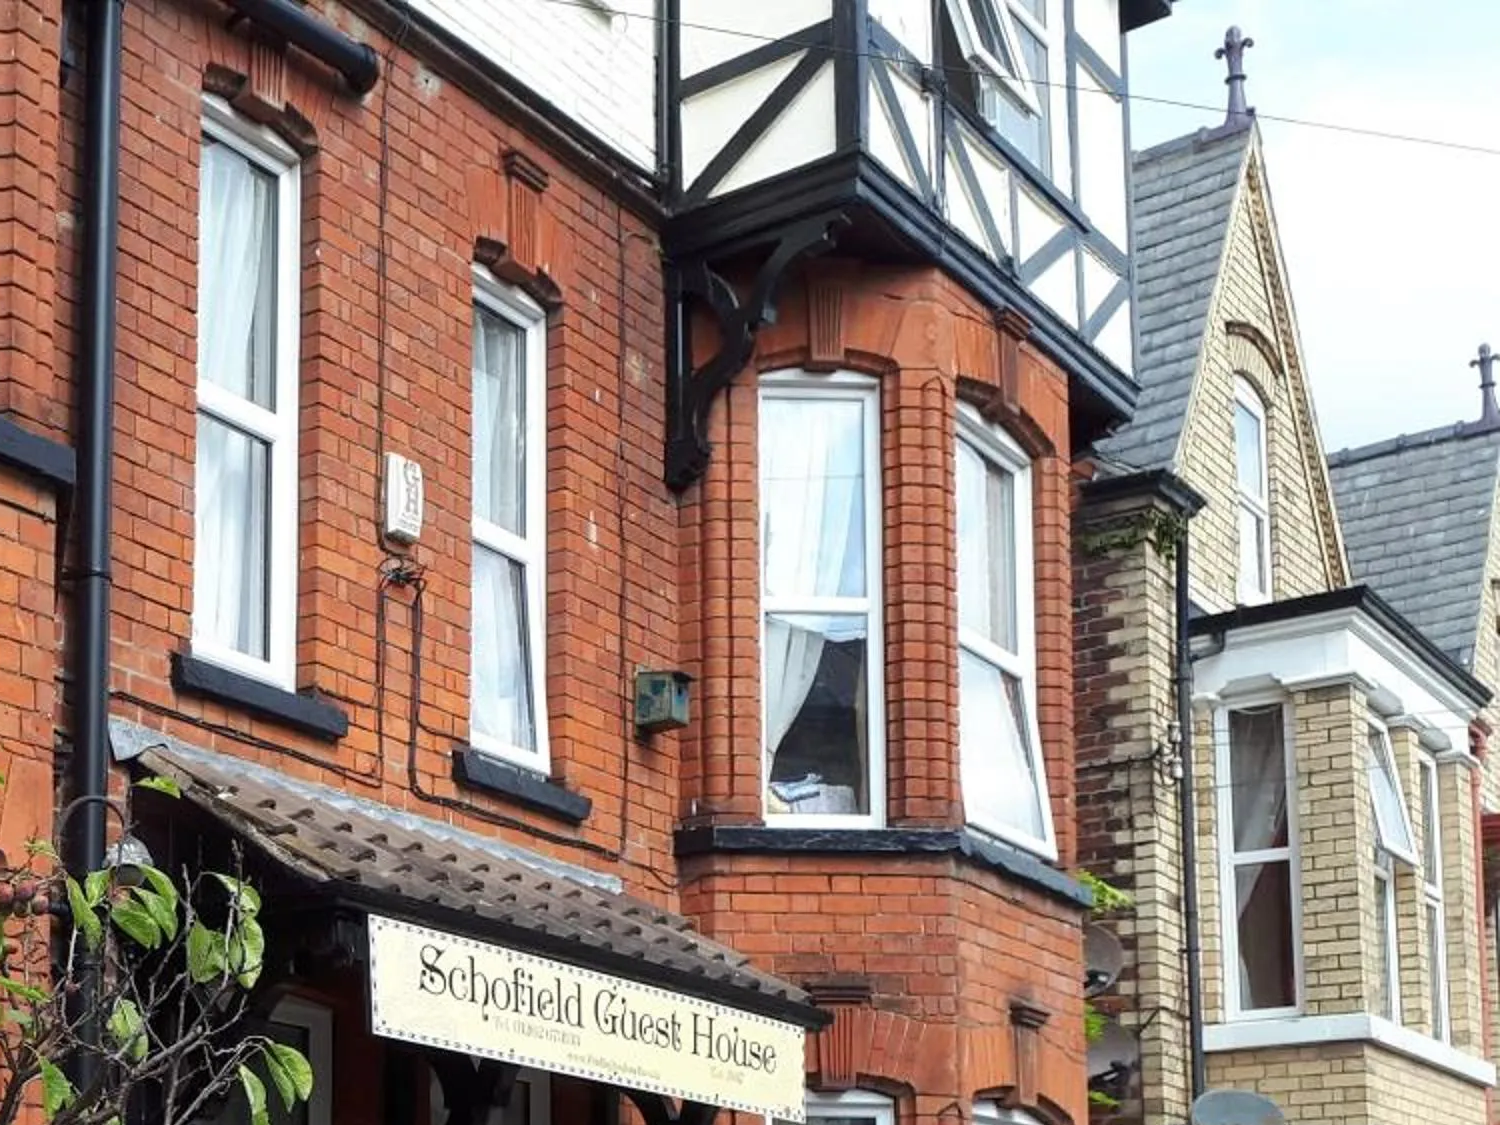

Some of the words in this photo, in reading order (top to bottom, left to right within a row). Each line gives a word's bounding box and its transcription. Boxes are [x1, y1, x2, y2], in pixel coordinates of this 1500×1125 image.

[418, 944, 584, 1029] Schofield
[593, 987, 683, 1052] Guest
[691, 1012, 777, 1074] House
